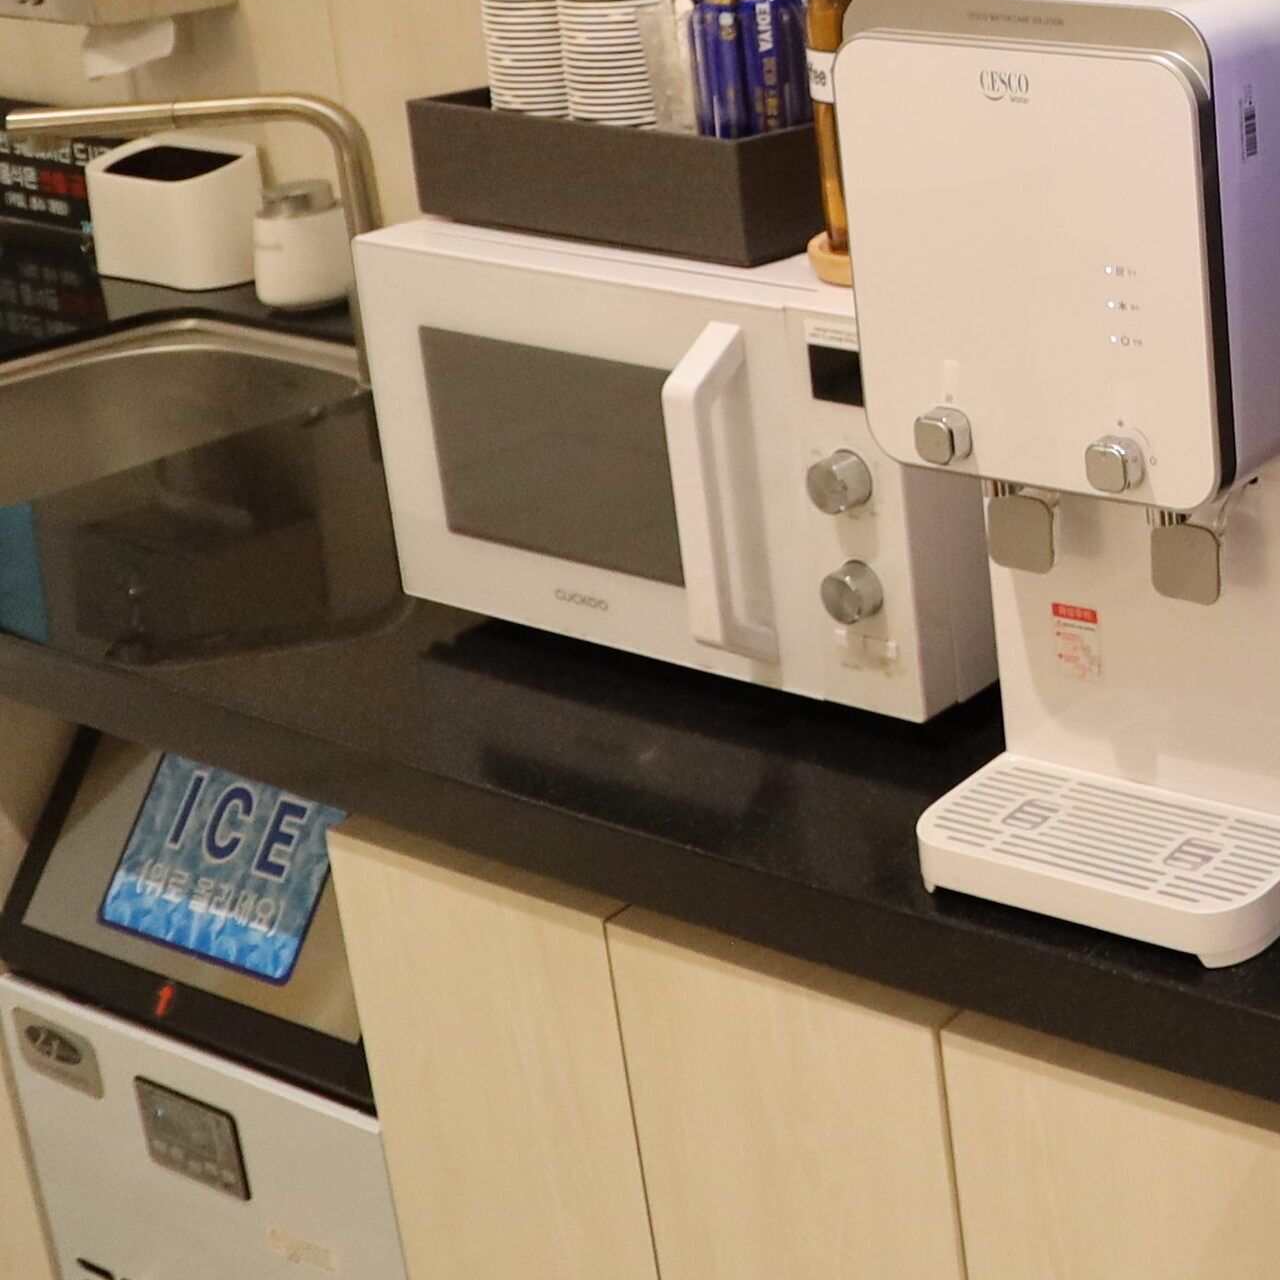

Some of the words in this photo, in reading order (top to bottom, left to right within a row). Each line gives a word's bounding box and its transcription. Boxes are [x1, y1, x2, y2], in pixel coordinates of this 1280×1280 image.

[754, 2, 775, 53] EDIYA
[979, 69, 1030, 94] CESCO
[167, 771, 314, 882] ICE
